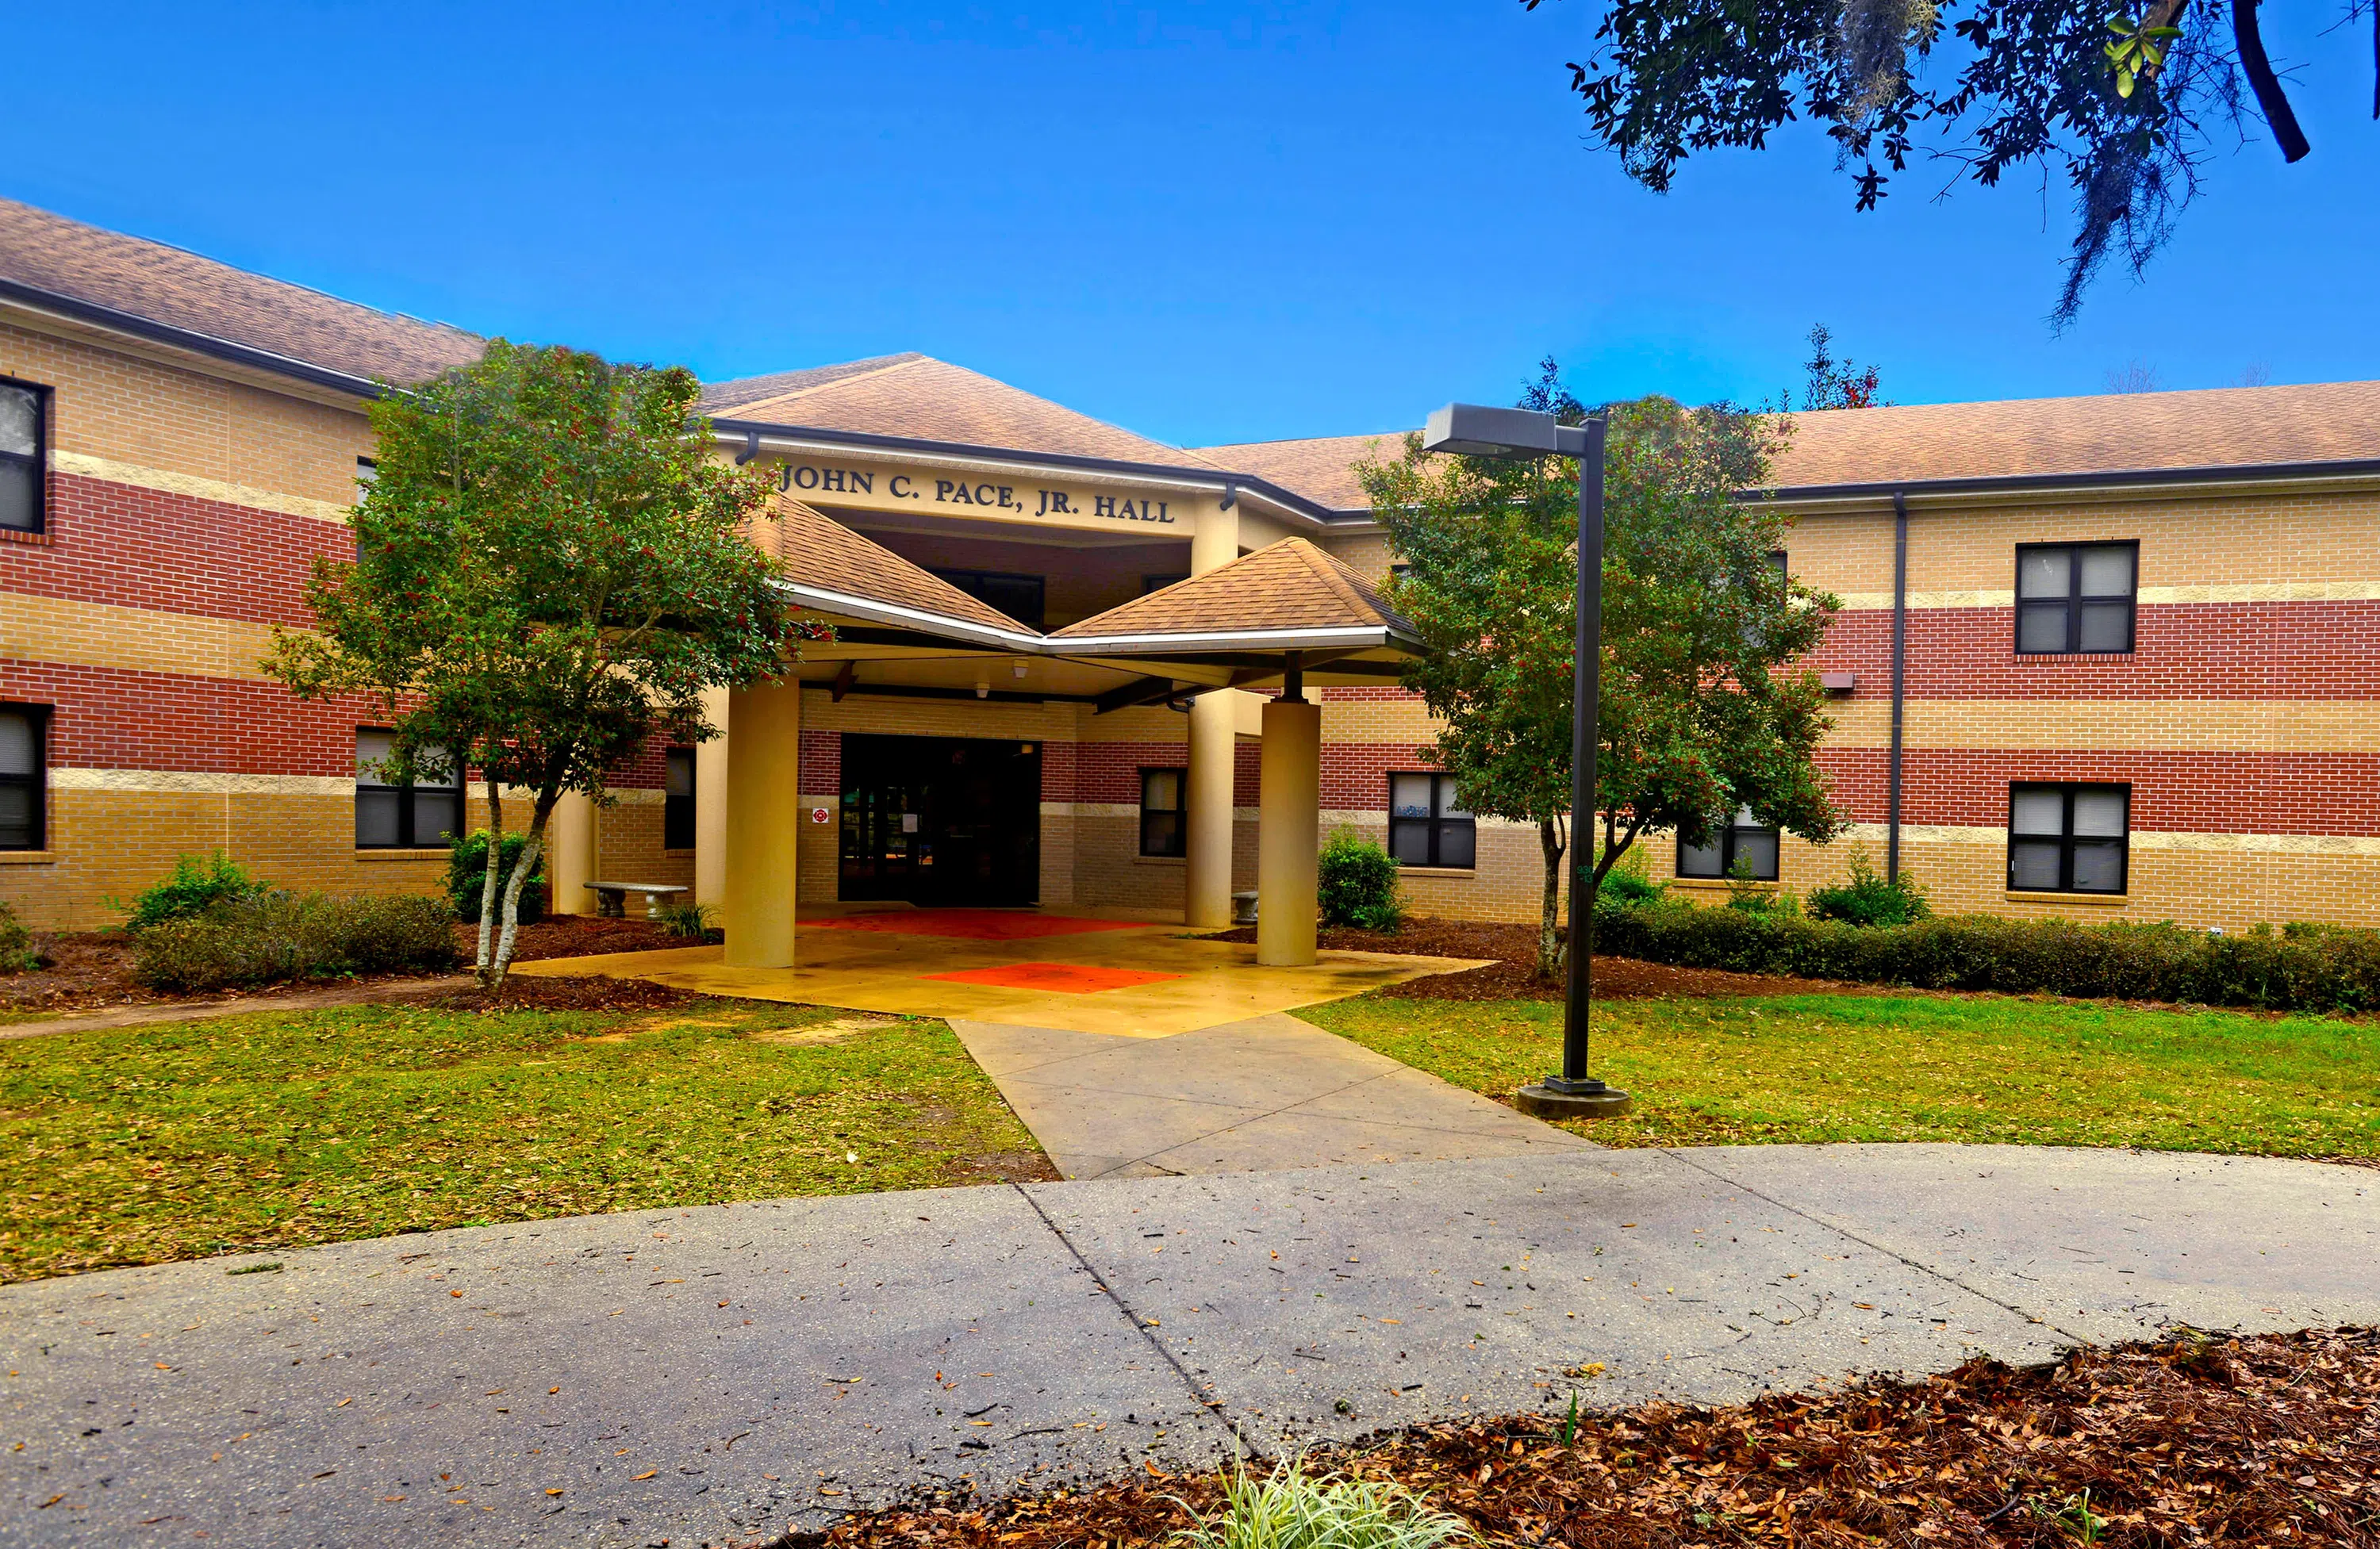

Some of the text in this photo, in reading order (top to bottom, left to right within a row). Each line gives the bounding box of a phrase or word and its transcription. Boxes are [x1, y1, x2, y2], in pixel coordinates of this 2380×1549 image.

[778, 465, 1175, 523] JOHN C. PACE, JR. HALL
